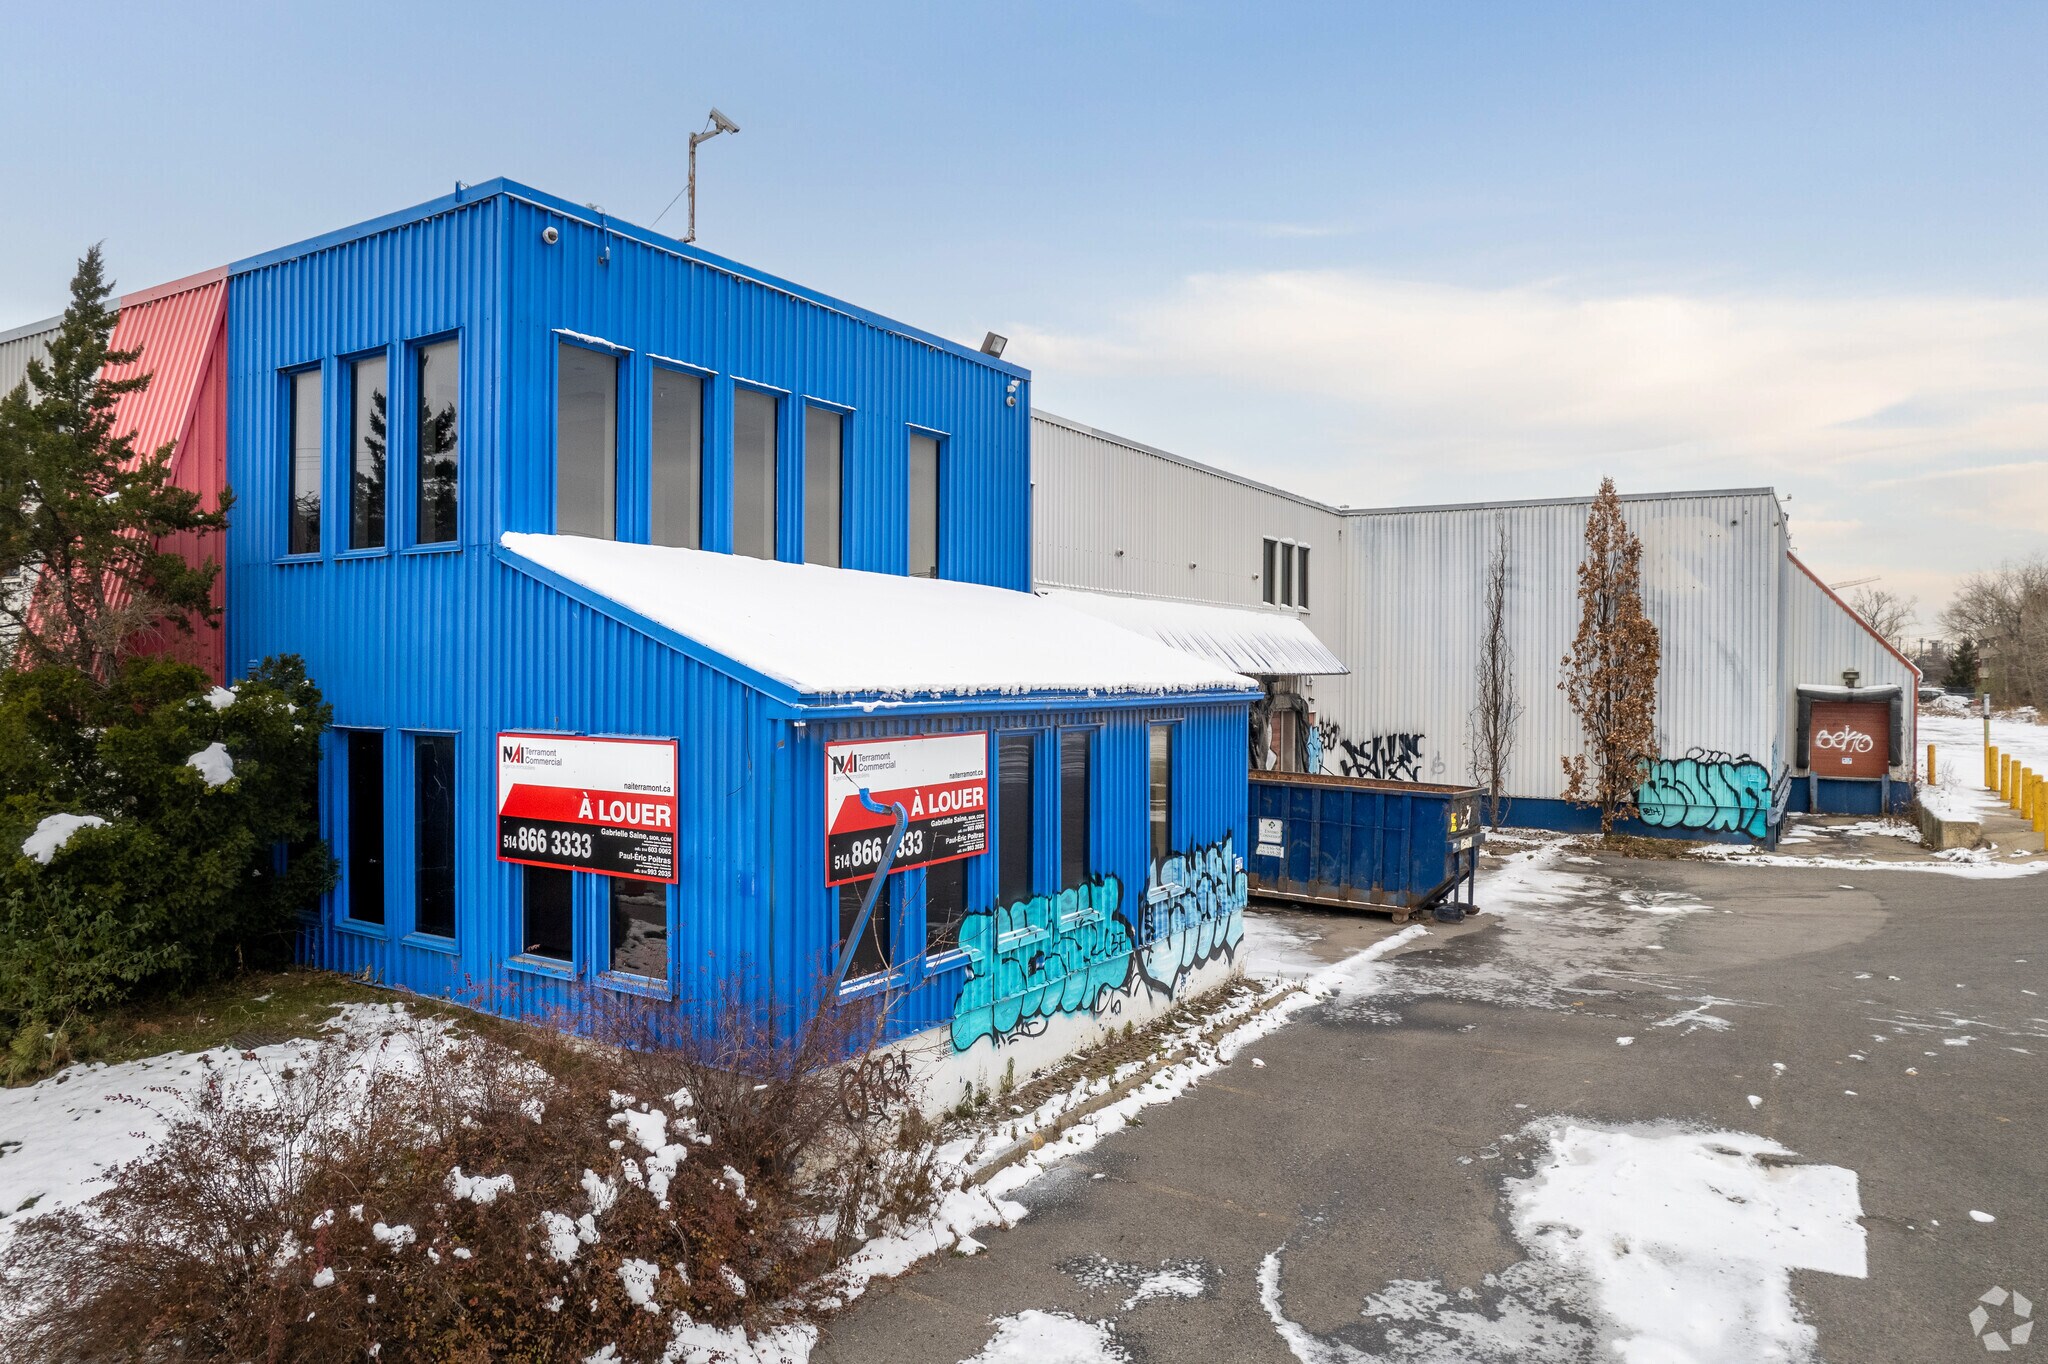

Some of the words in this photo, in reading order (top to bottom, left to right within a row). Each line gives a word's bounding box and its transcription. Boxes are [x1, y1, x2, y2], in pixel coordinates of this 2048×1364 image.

[503, 743, 524, 763] NAI
[525, 747, 557, 757] Terramont
[858, 752, 890, 762] Terramont
[525, 756, 562, 766] Commercial
[832, 750, 858, 775] NAI
[858, 760, 896, 772] Commercial
[949, 769, 984, 780] naiterramont.ca
[623, 782, 671, 793] naiterramont.ca
[911, 789, 924, 817] À
[928, 786, 984, 813] LOUER
[578, 792, 594, 819] À
[598, 799, 671, 827] LOUER
[930, 818, 953, 827] Gabrielle
[601, 828, 628, 838] Gabrielle
[503, 834, 517, 849] 514
[518, 826, 547, 853] 866
[551, 830, 592, 859] 3333
[618, 852, 647, 861] Paul-Éric
[648, 855, 671, 864] Poitras
[834, 853, 850, 870] 514
[851, 837, 882, 867] 866
